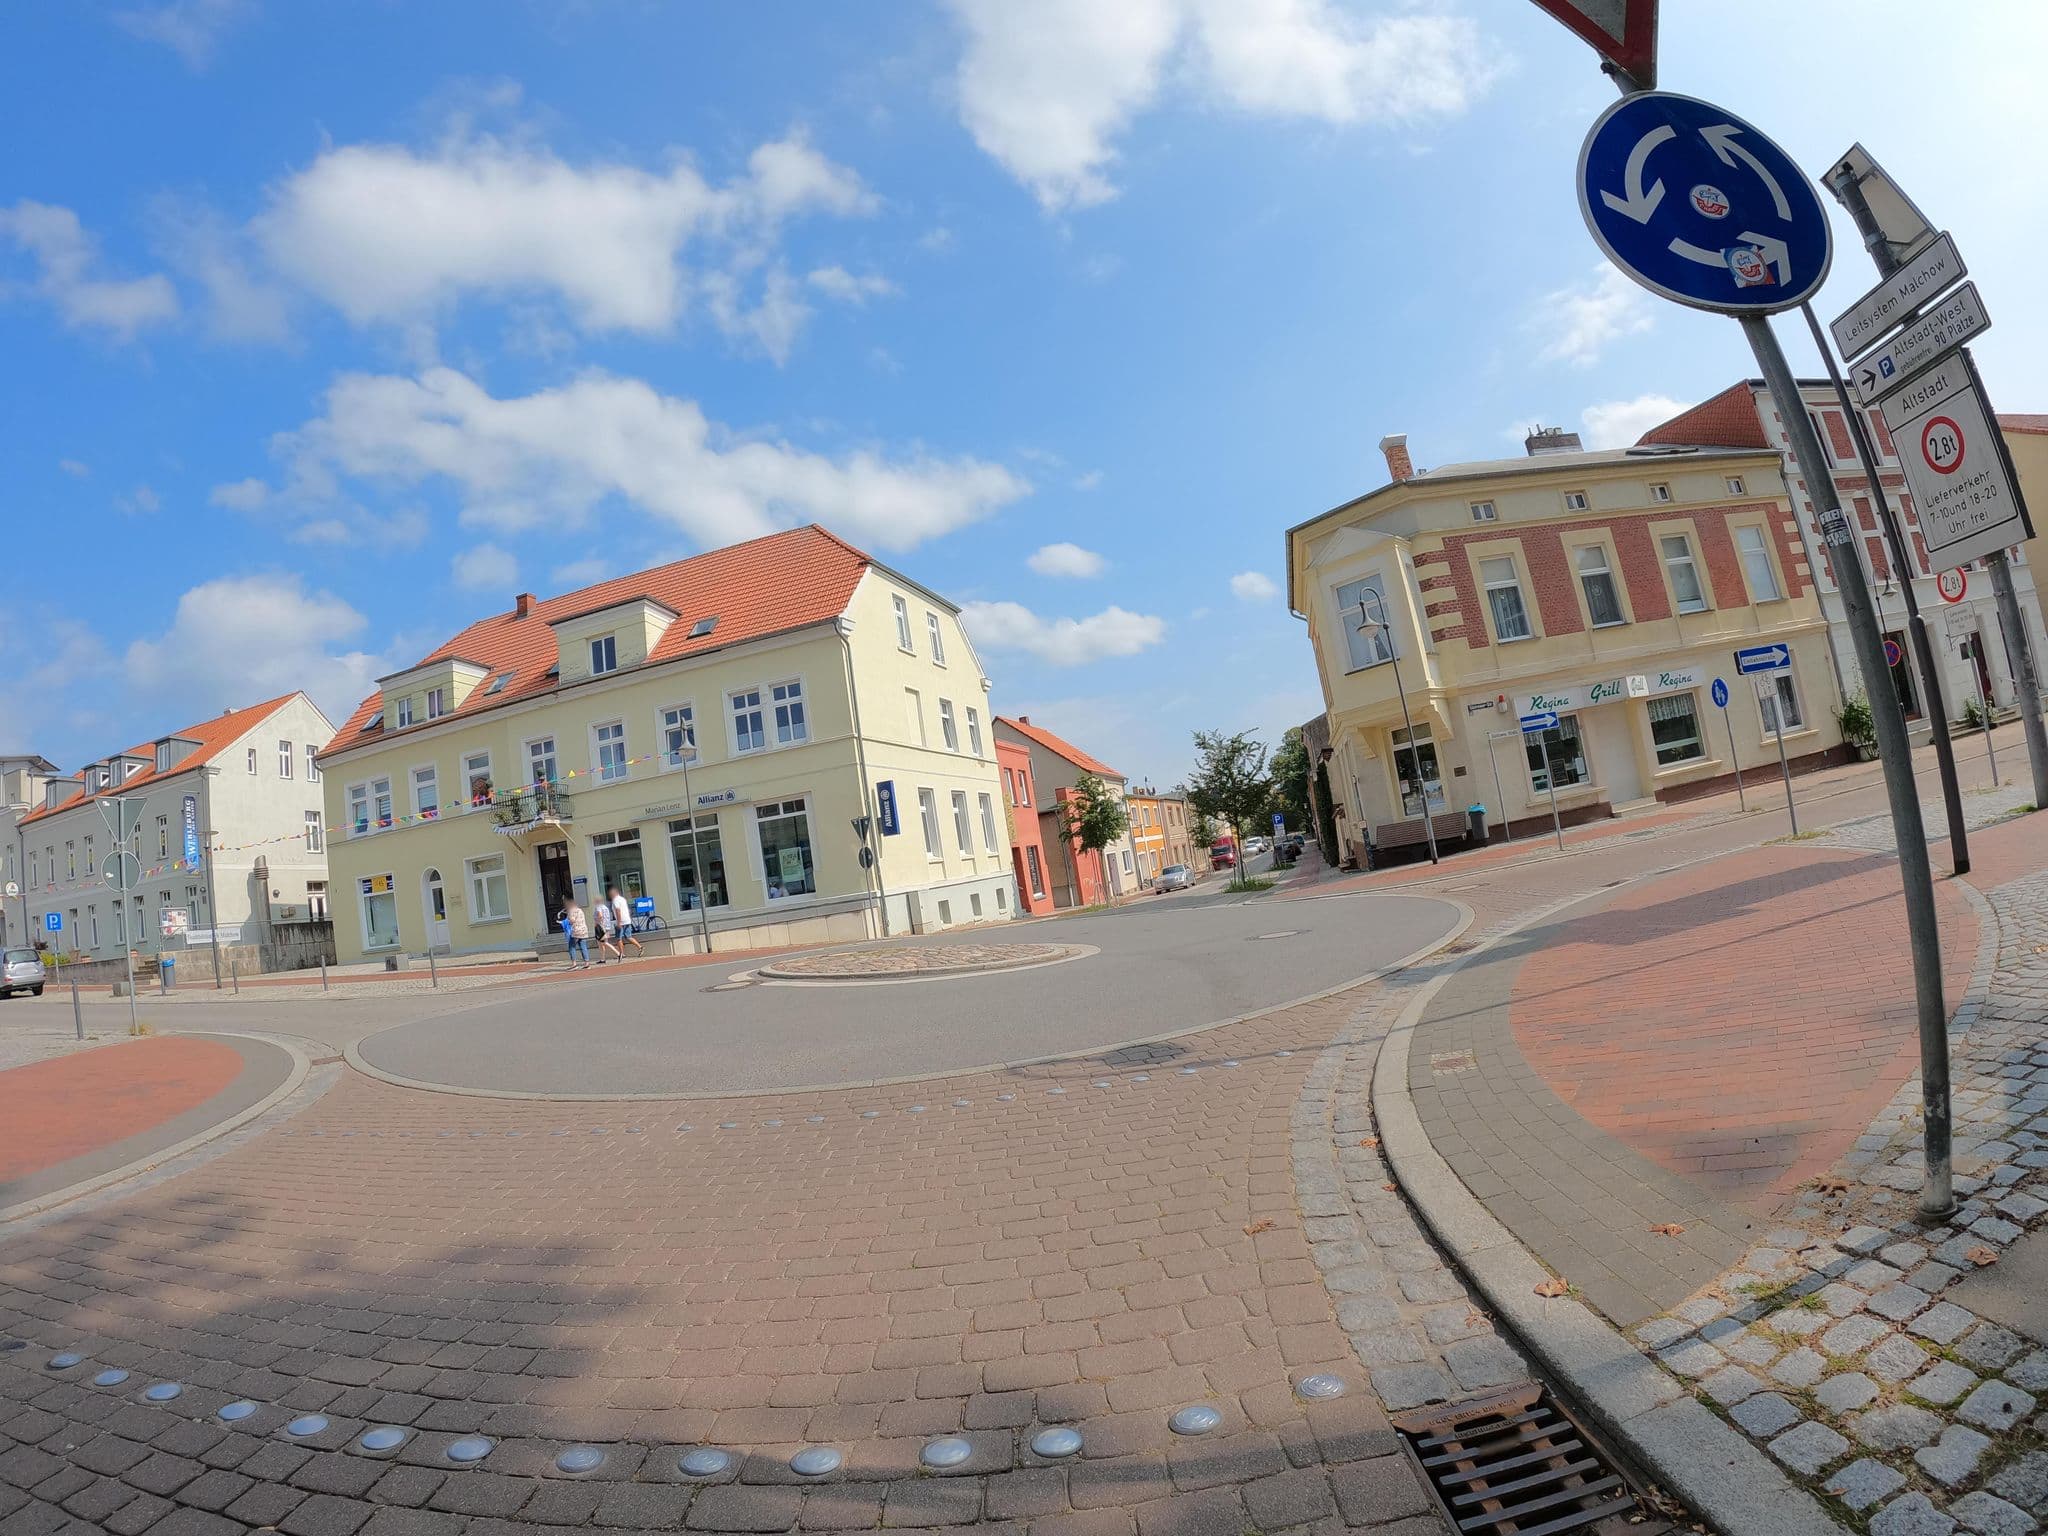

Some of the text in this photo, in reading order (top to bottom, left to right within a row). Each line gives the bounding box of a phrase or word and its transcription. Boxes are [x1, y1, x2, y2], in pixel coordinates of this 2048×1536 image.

[1845, 258, 1946, 342] Leitsystem Malchow
[1893, 300, 1967, 357] Altstadt-West
[1934, 331, 1947, 348] 90
[1947, 314, 1975, 338] Plätze
[1902, 374, 1949, 414] Altstadt
[1925, 470, 1991, 508] Lieferverkehr
[1970, 485, 1998, 505] 18-20
[1950, 507, 1990, 534] Uhr frei
[1530, 680, 1621, 712] Regina Grill
[1658, 672, 1693, 689] Regina
[697, 793, 725, 805] Allianz
[883, 800, 893, 827] Allianz
